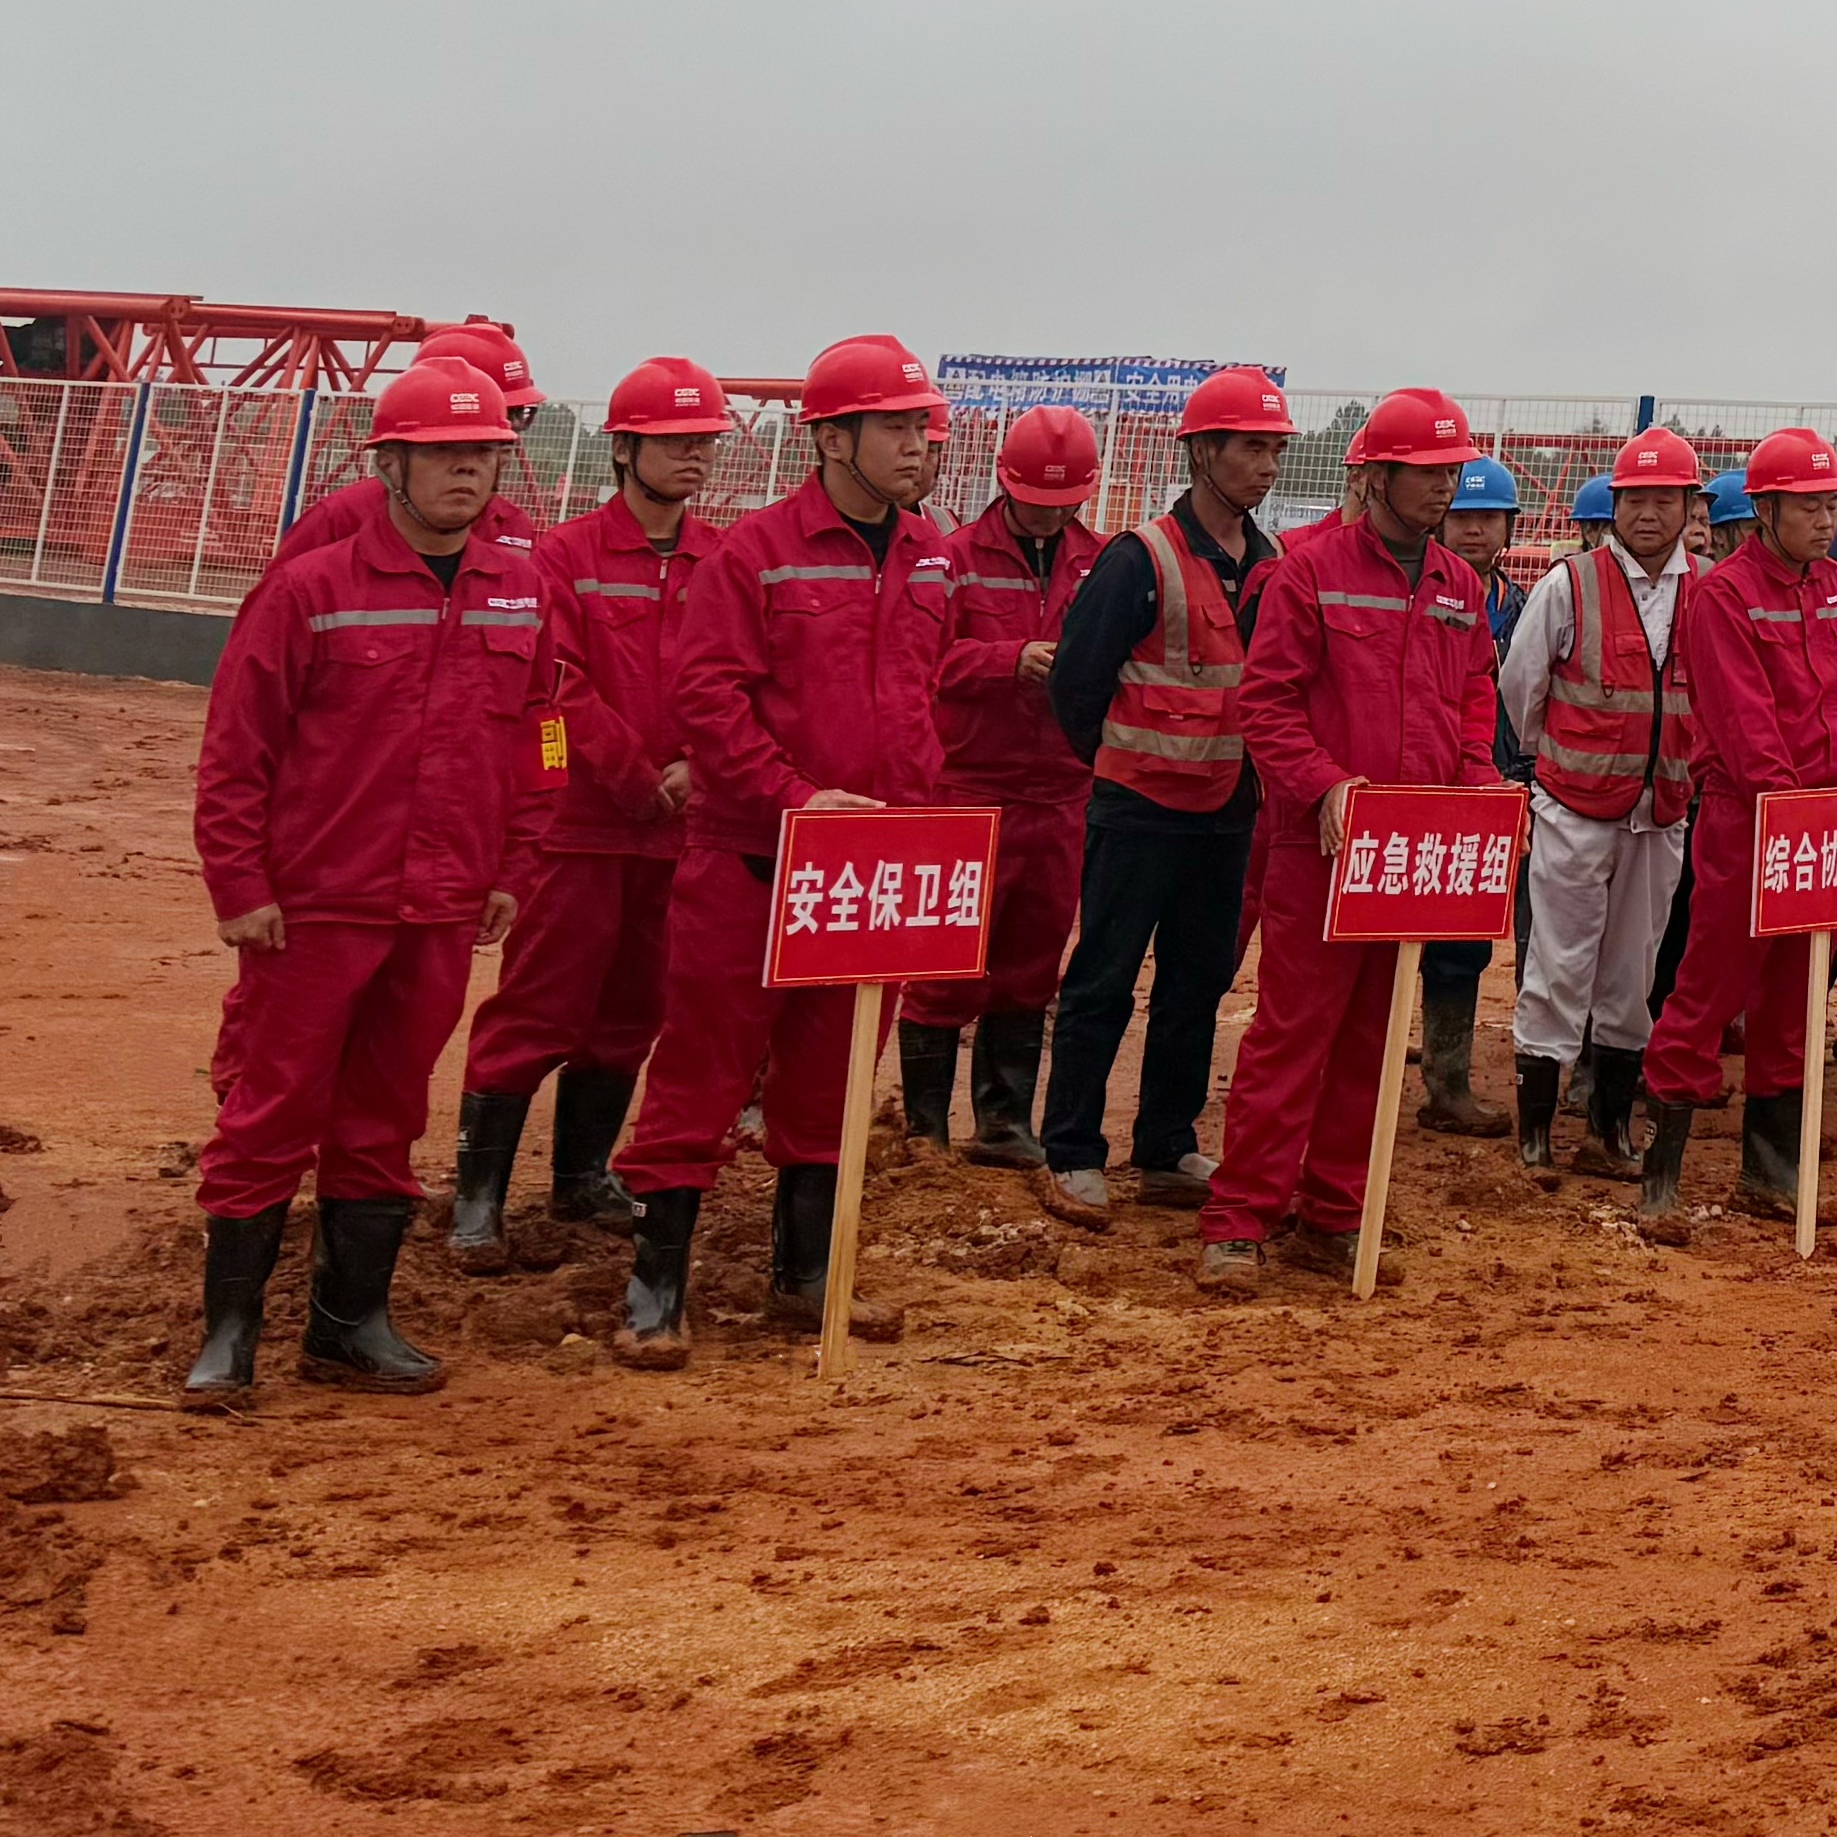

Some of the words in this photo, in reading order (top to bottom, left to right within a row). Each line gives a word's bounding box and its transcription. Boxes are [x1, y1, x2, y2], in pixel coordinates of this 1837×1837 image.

[785, 859, 984, 936] 安全保卫组
[1342, 830, 1513, 896] 应急救援组
